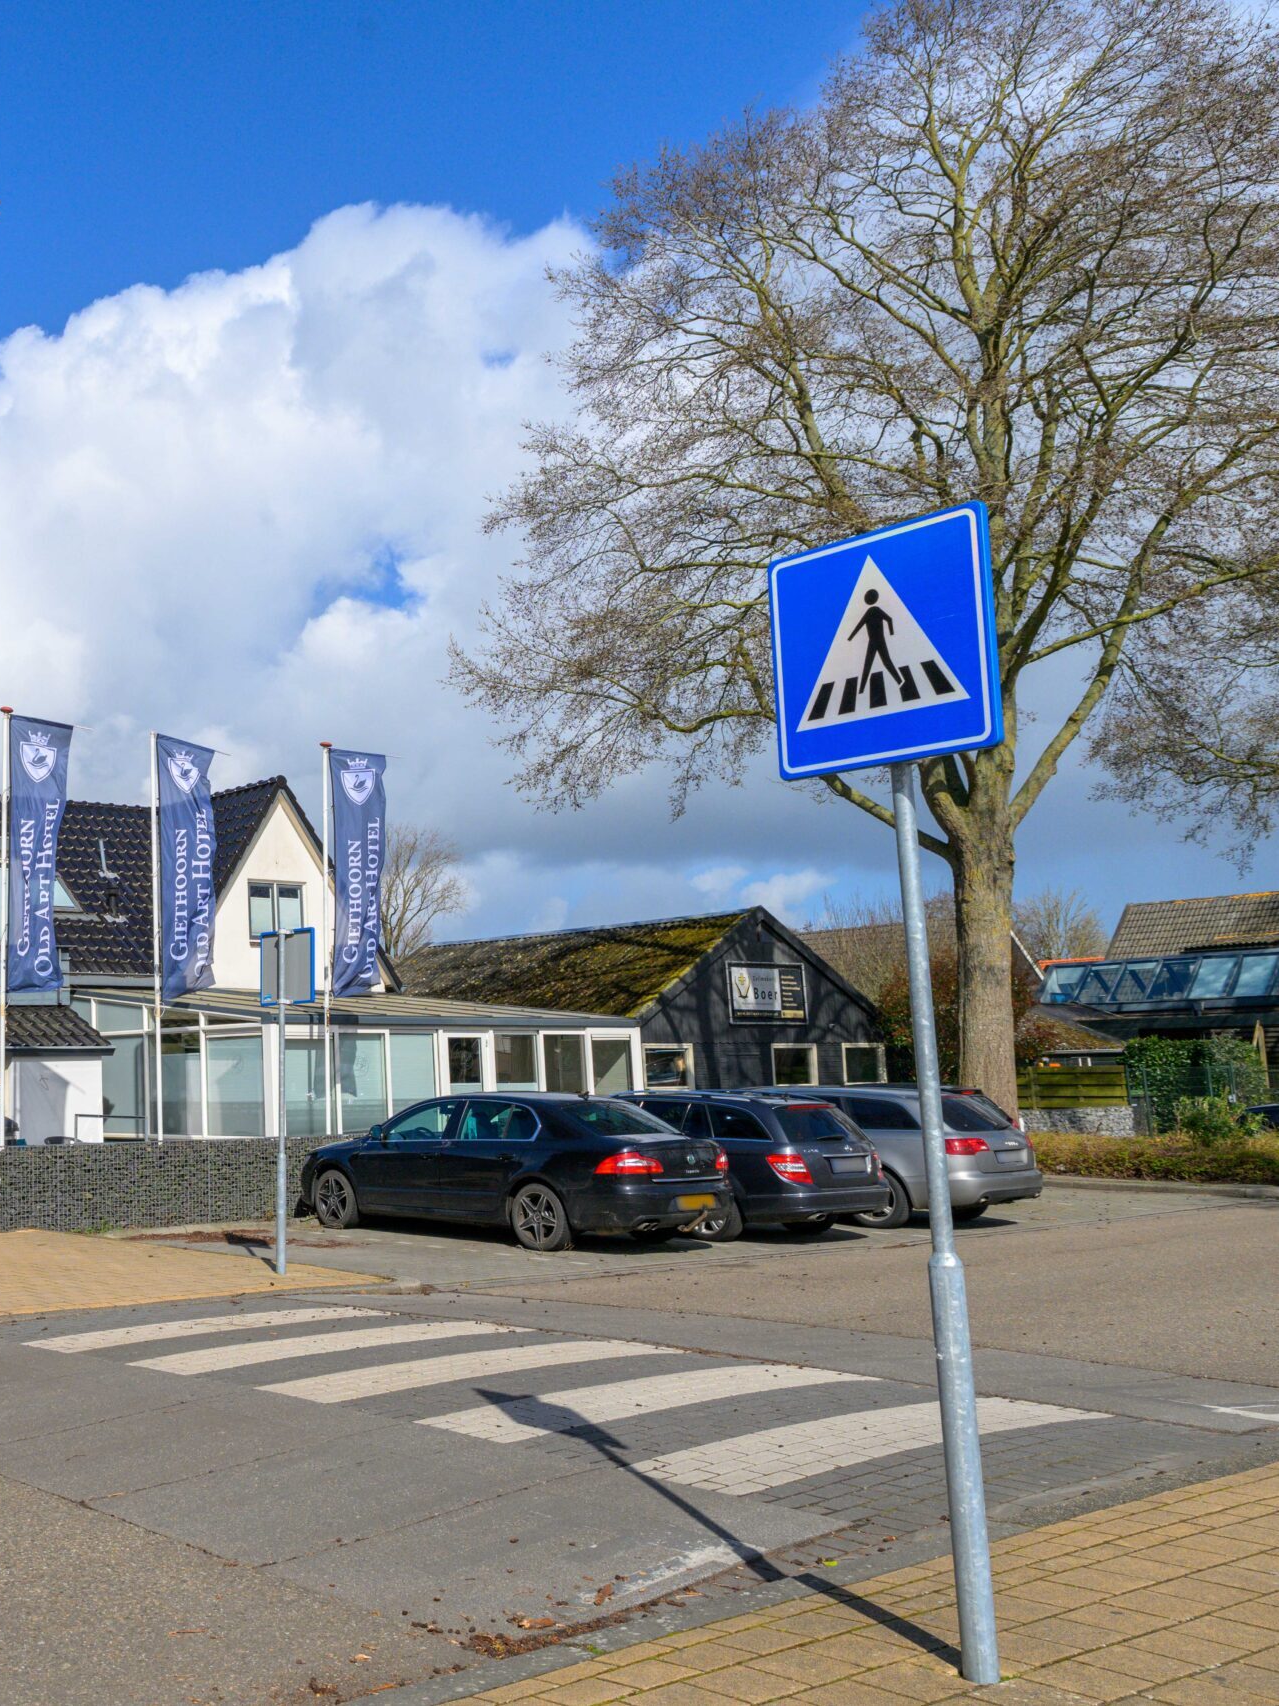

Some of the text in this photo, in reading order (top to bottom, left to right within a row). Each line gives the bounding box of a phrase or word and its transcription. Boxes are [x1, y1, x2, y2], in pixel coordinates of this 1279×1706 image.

[191, 808, 211, 880] HOTEL
[365, 816, 380, 889] HOTEL
[34, 873, 50, 922] ART
[170, 829, 188, 961] GIETHOORN
[191, 884, 211, 927] ART
[342, 839, 362, 964] GIETHOORN
[34, 926, 53, 977] OLD
[754, 987, 778, 1000] Boer
